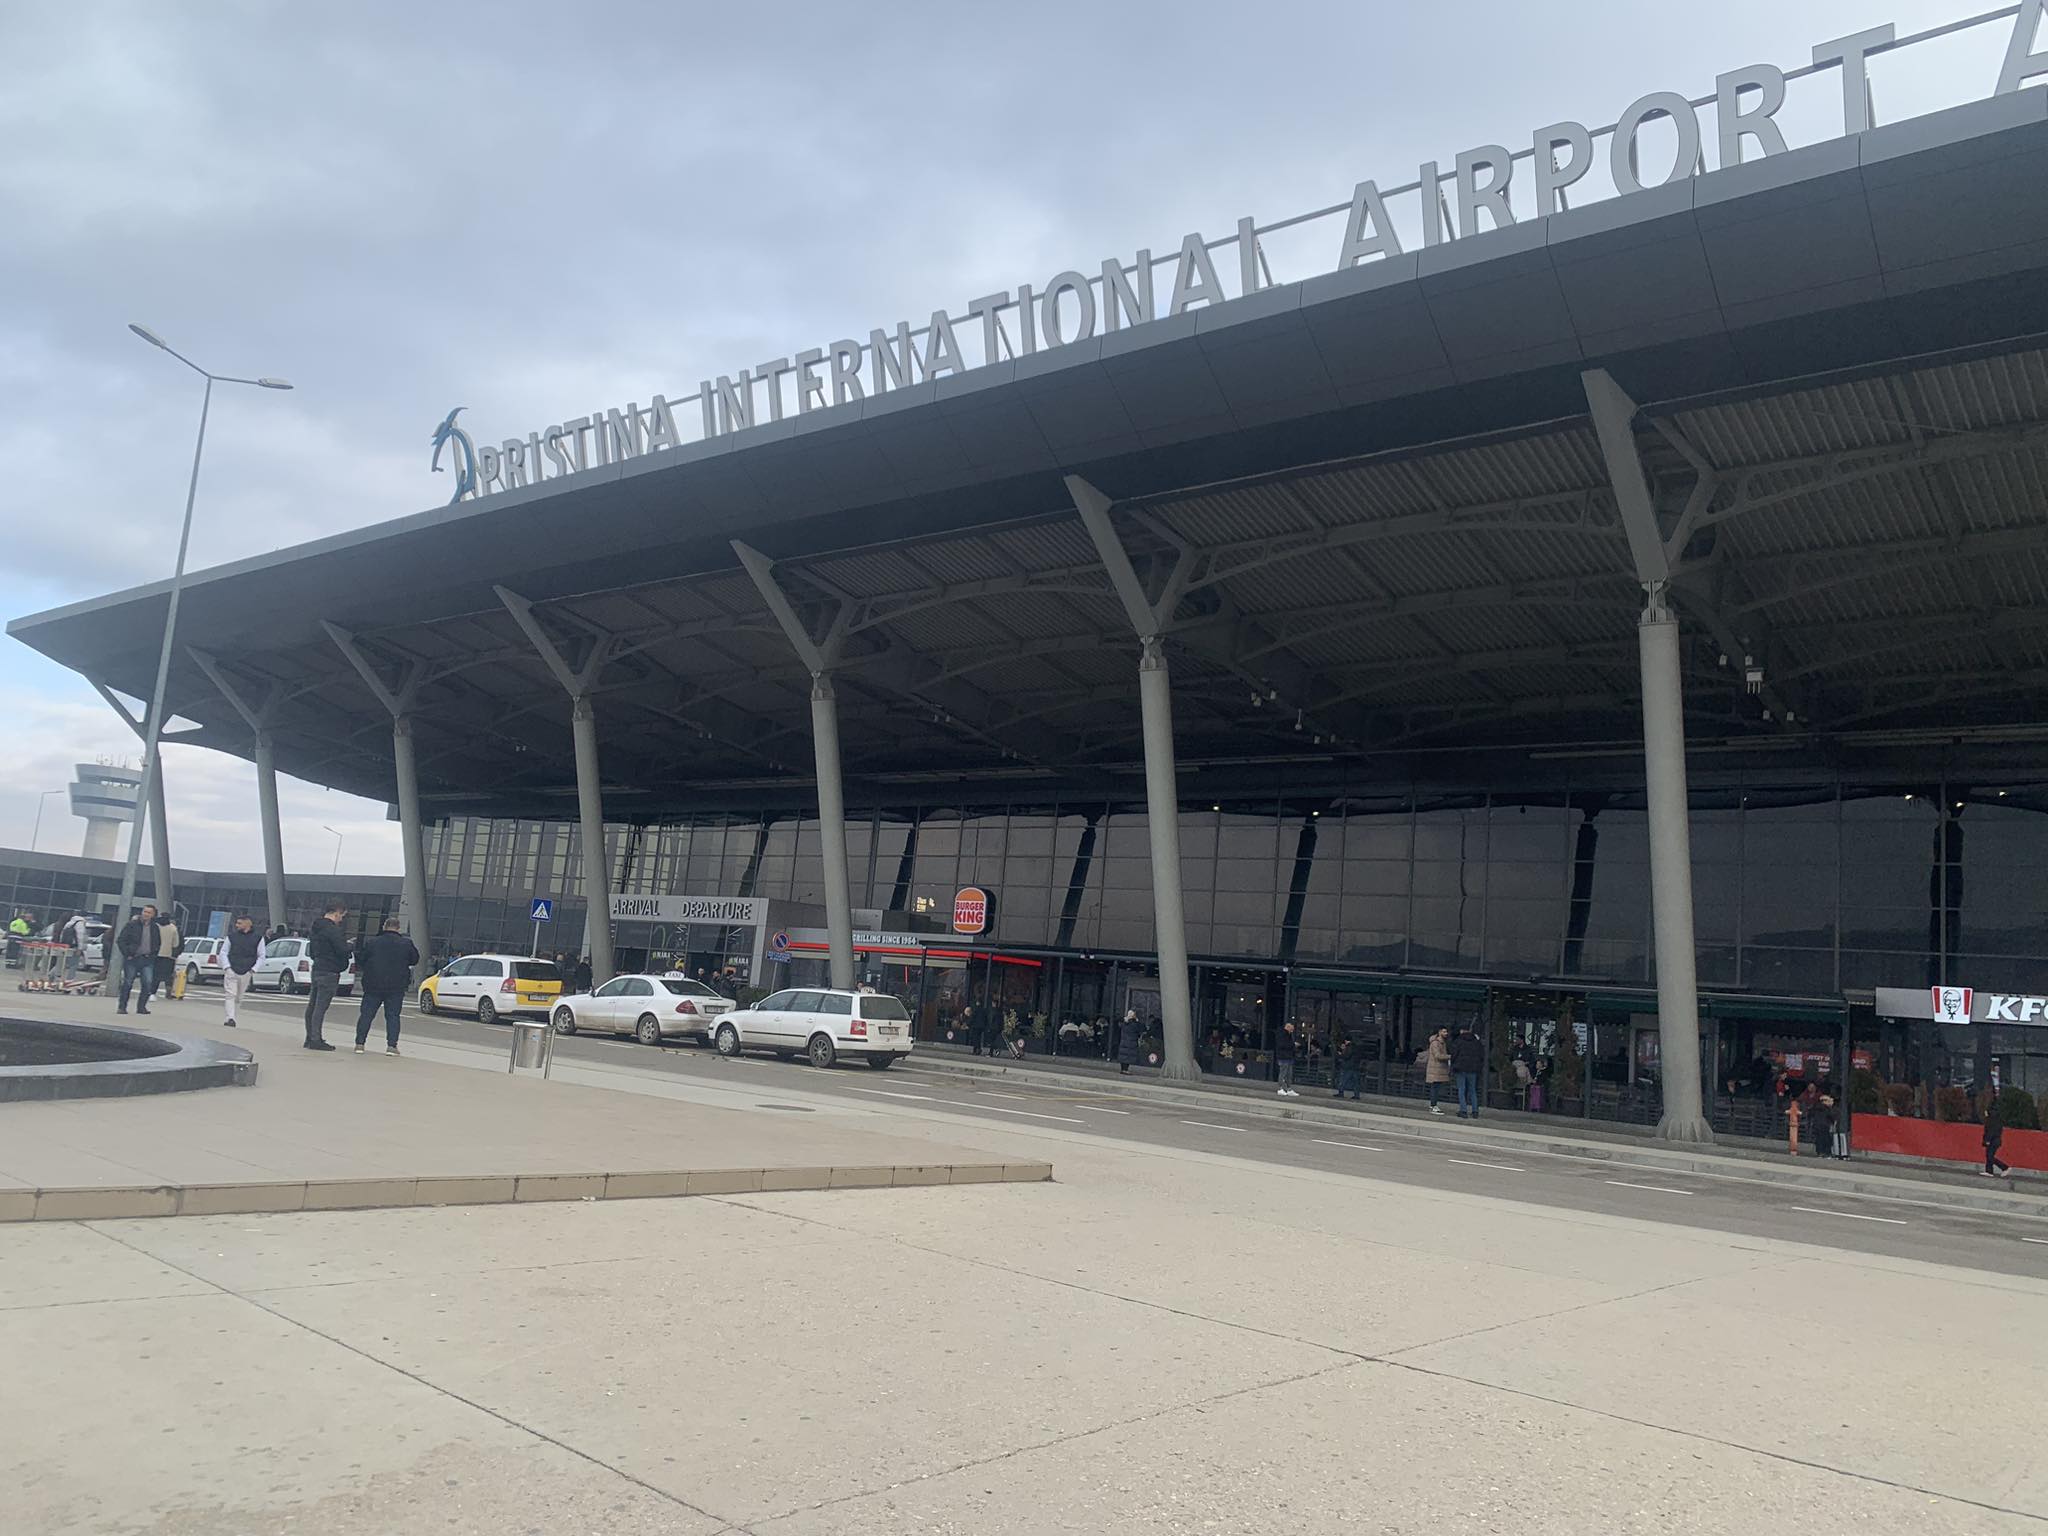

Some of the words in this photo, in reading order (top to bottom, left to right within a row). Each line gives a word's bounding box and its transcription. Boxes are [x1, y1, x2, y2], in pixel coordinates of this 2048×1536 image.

[478, 394, 680, 496] PRISTINA
[699, 216, 1283, 438] INTERNATIONAL
[1338, 22, 1895, 272] AIRPORT
[612, 899, 660, 916] ARRIVAL
[681, 900, 752, 920] DEPARTURE
[955, 901, 984, 911] BURGER
[955, 911, 983, 923] KING
[882, 935, 900, 944] SINCE
[901, 936, 917, 945] 1954
